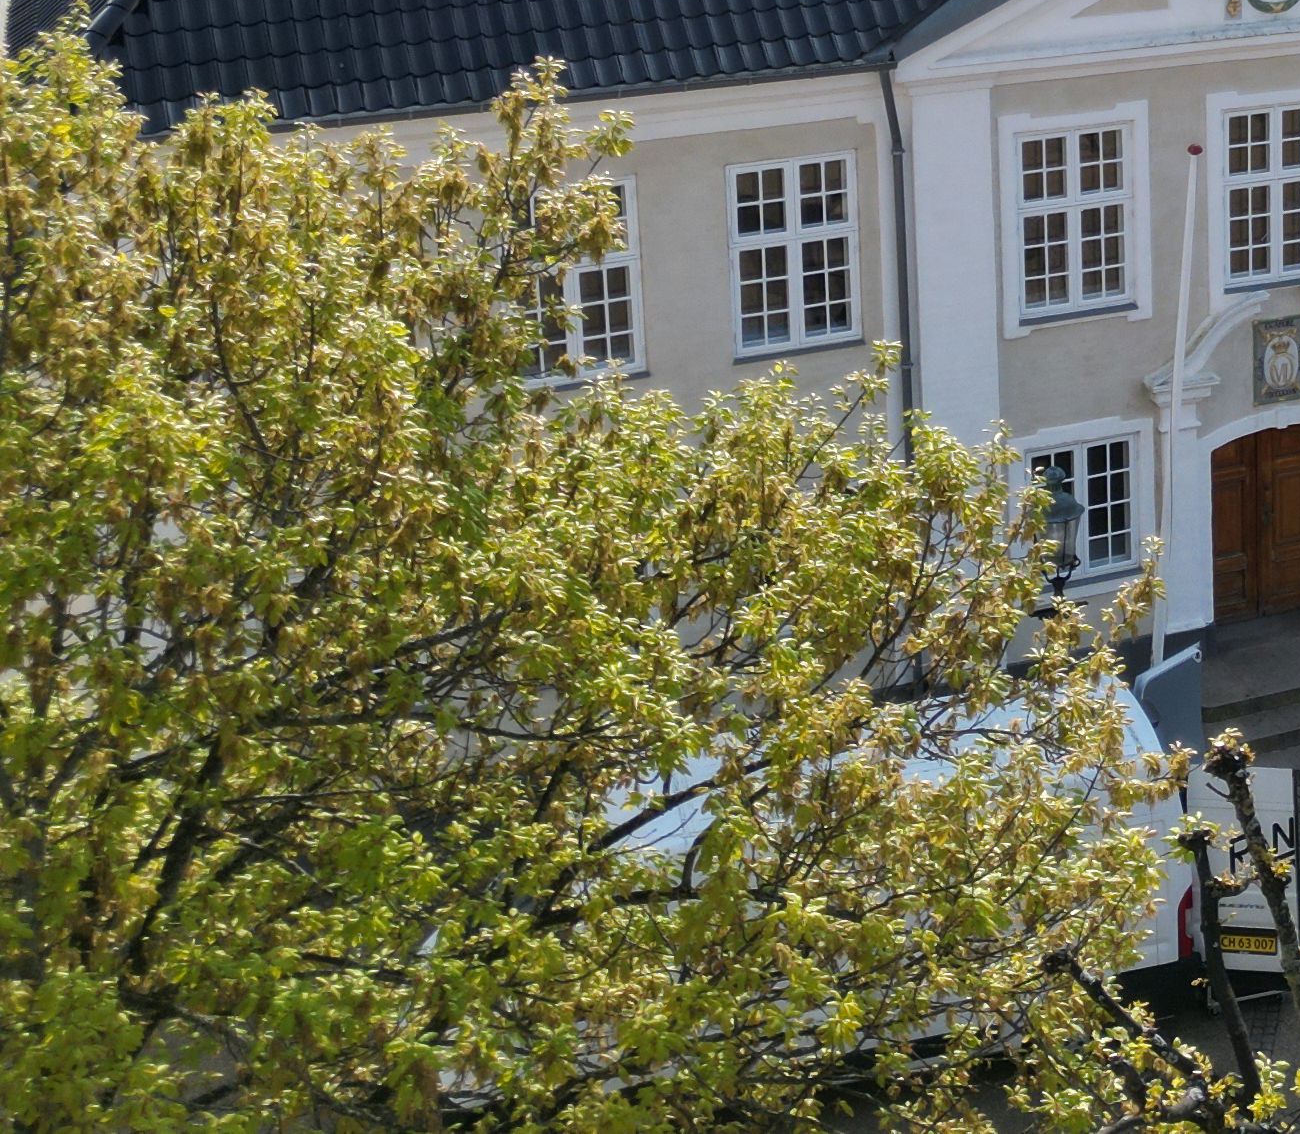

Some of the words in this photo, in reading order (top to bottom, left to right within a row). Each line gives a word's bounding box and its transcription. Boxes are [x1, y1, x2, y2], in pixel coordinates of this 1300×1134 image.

[1221, 936, 1236, 948] CH
[1238, 938, 1252, 949] 63
[1254, 939, 1275, 951] 007
